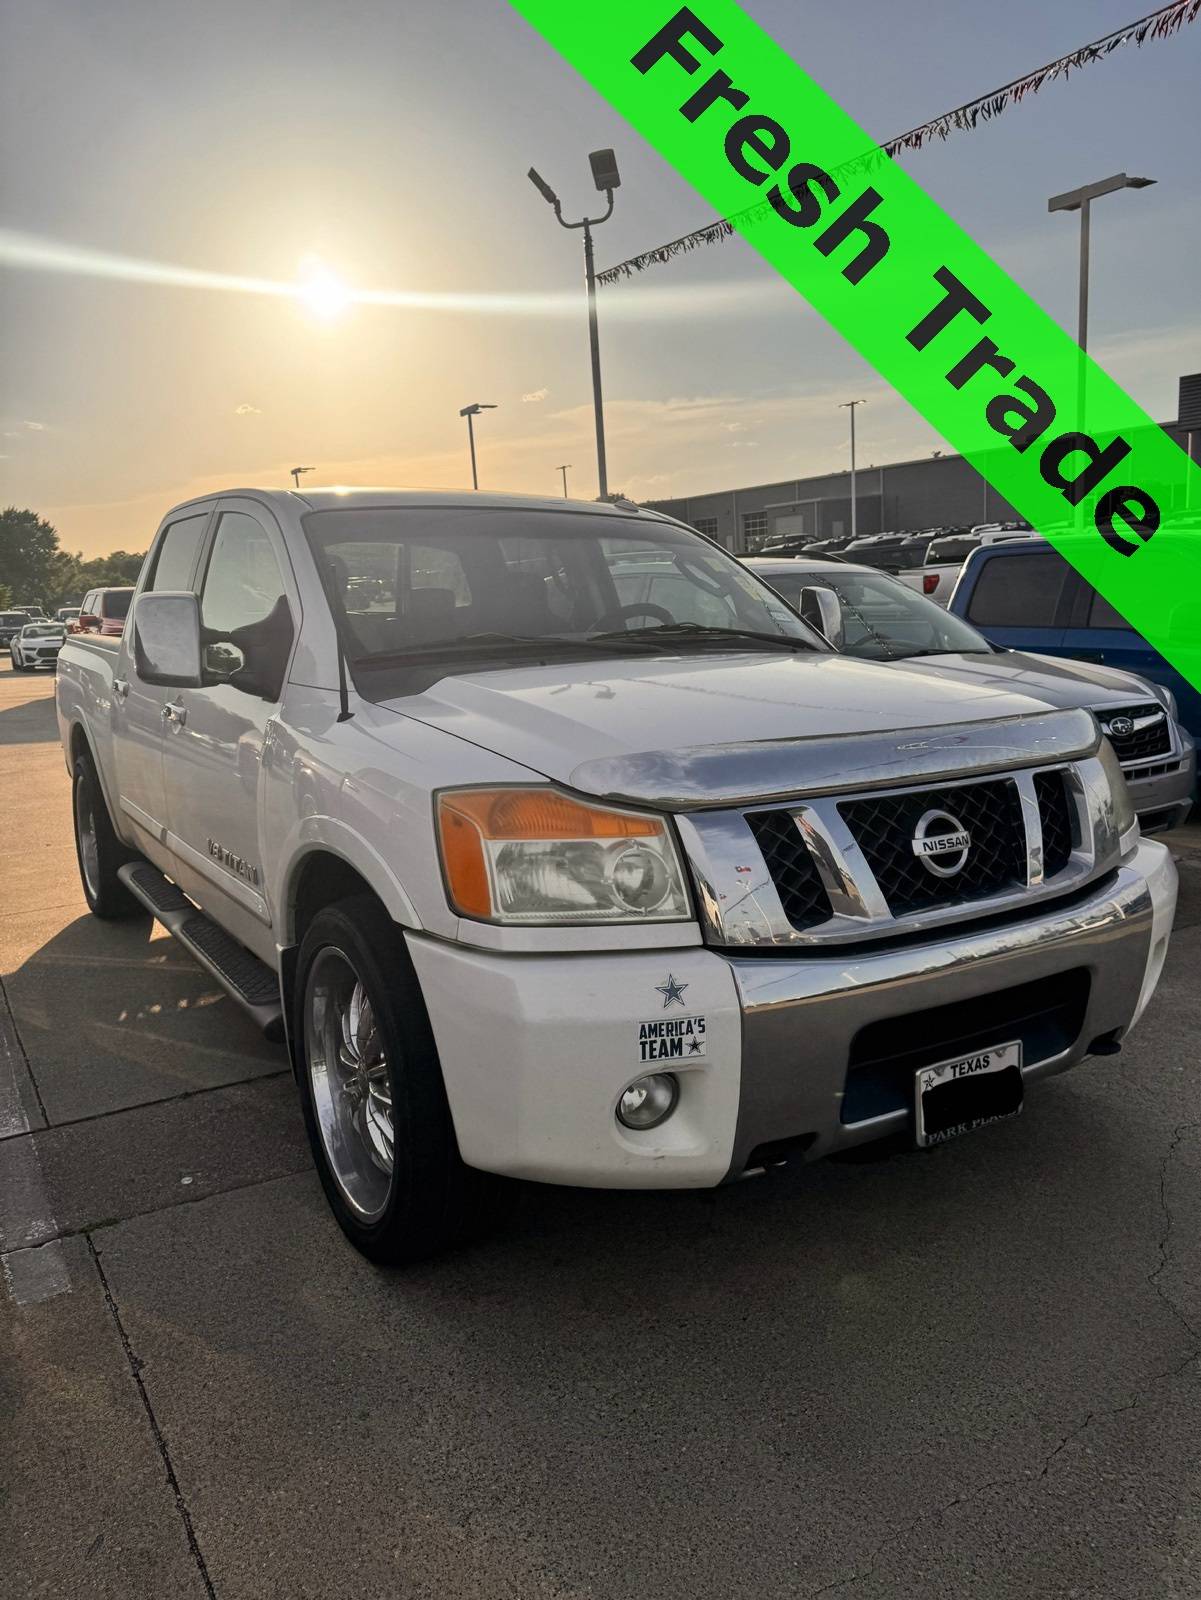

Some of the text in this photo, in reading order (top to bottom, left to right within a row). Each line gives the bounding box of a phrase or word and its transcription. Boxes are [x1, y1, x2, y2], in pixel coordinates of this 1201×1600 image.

[922, 834, 969, 852] NISSAN
[639, 1018, 706, 1040] AMERICA'S
[639, 1037, 683, 1060] TEAM
[950, 1055, 990, 1078] TEXAS
